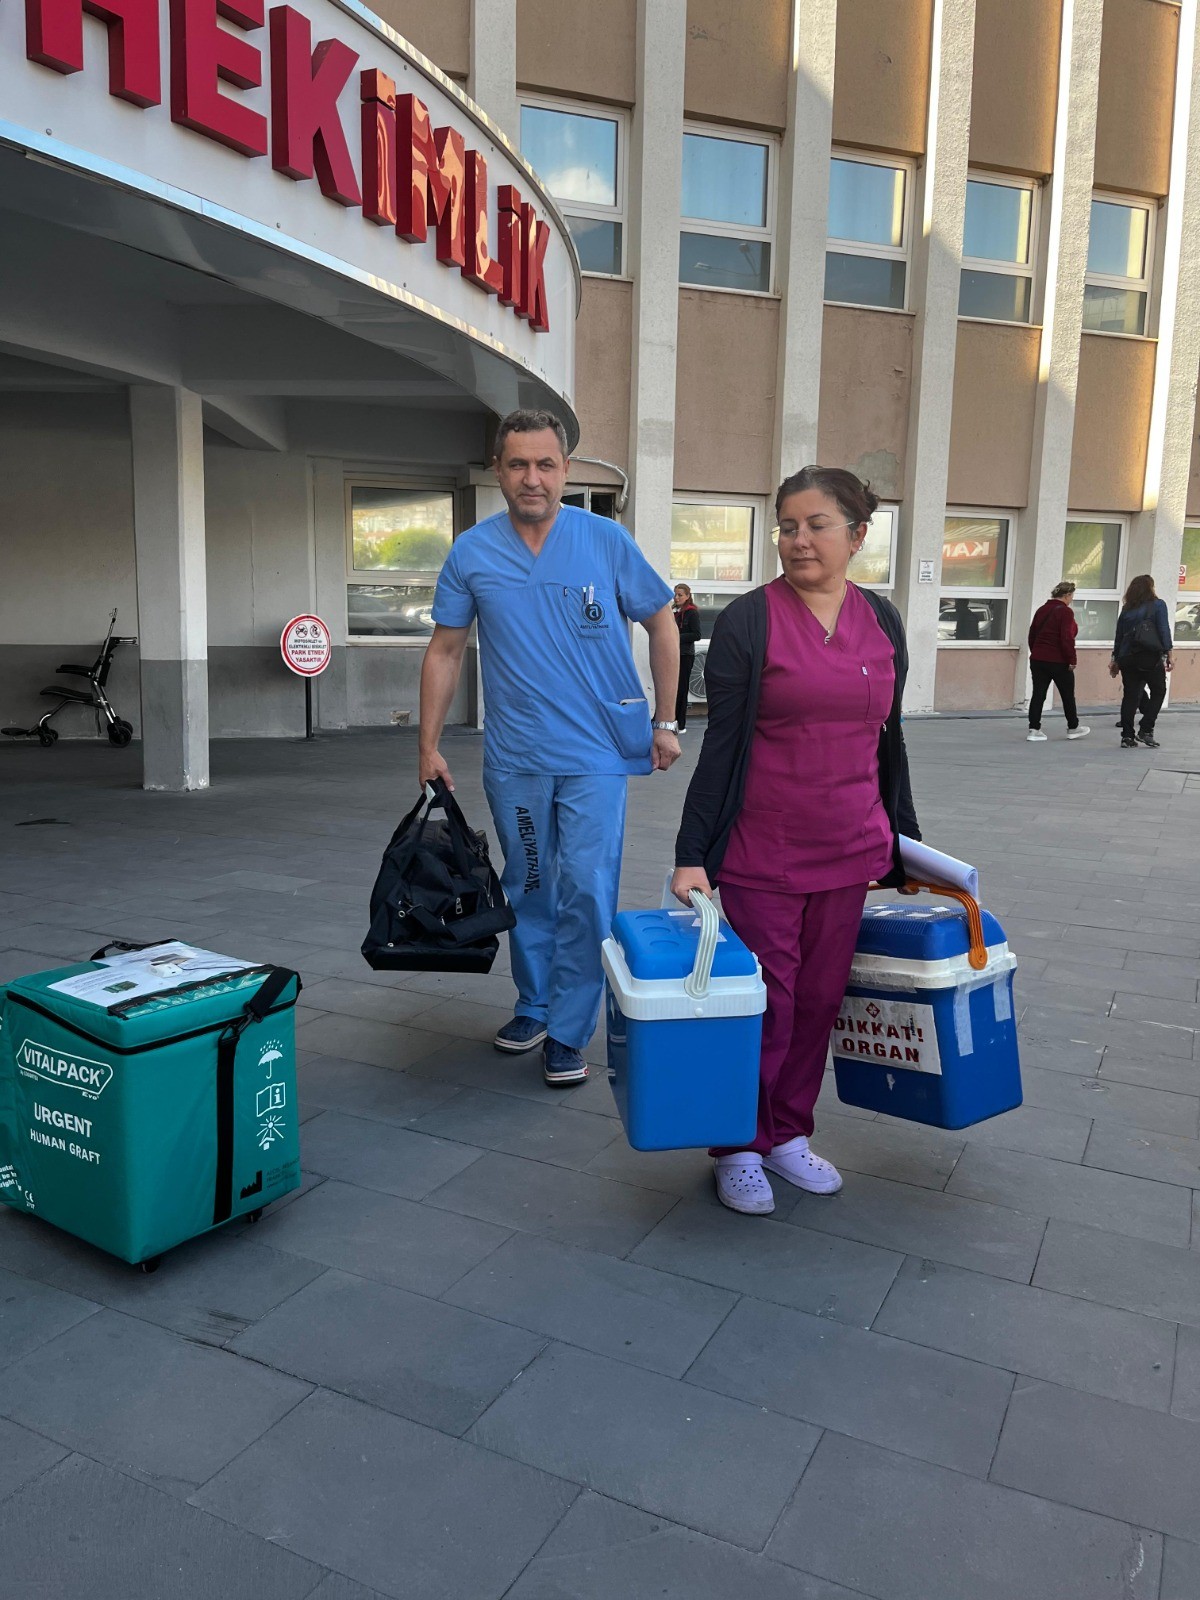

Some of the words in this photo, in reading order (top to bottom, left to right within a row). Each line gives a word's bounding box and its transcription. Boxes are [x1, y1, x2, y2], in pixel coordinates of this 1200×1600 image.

[842, 1037, 920, 1063] ORGAN
[33, 1102, 93, 1138] URGENT
[29, 1128, 66, 1151] HUMAN
[69, 1142, 101, 1165] GRAFT
